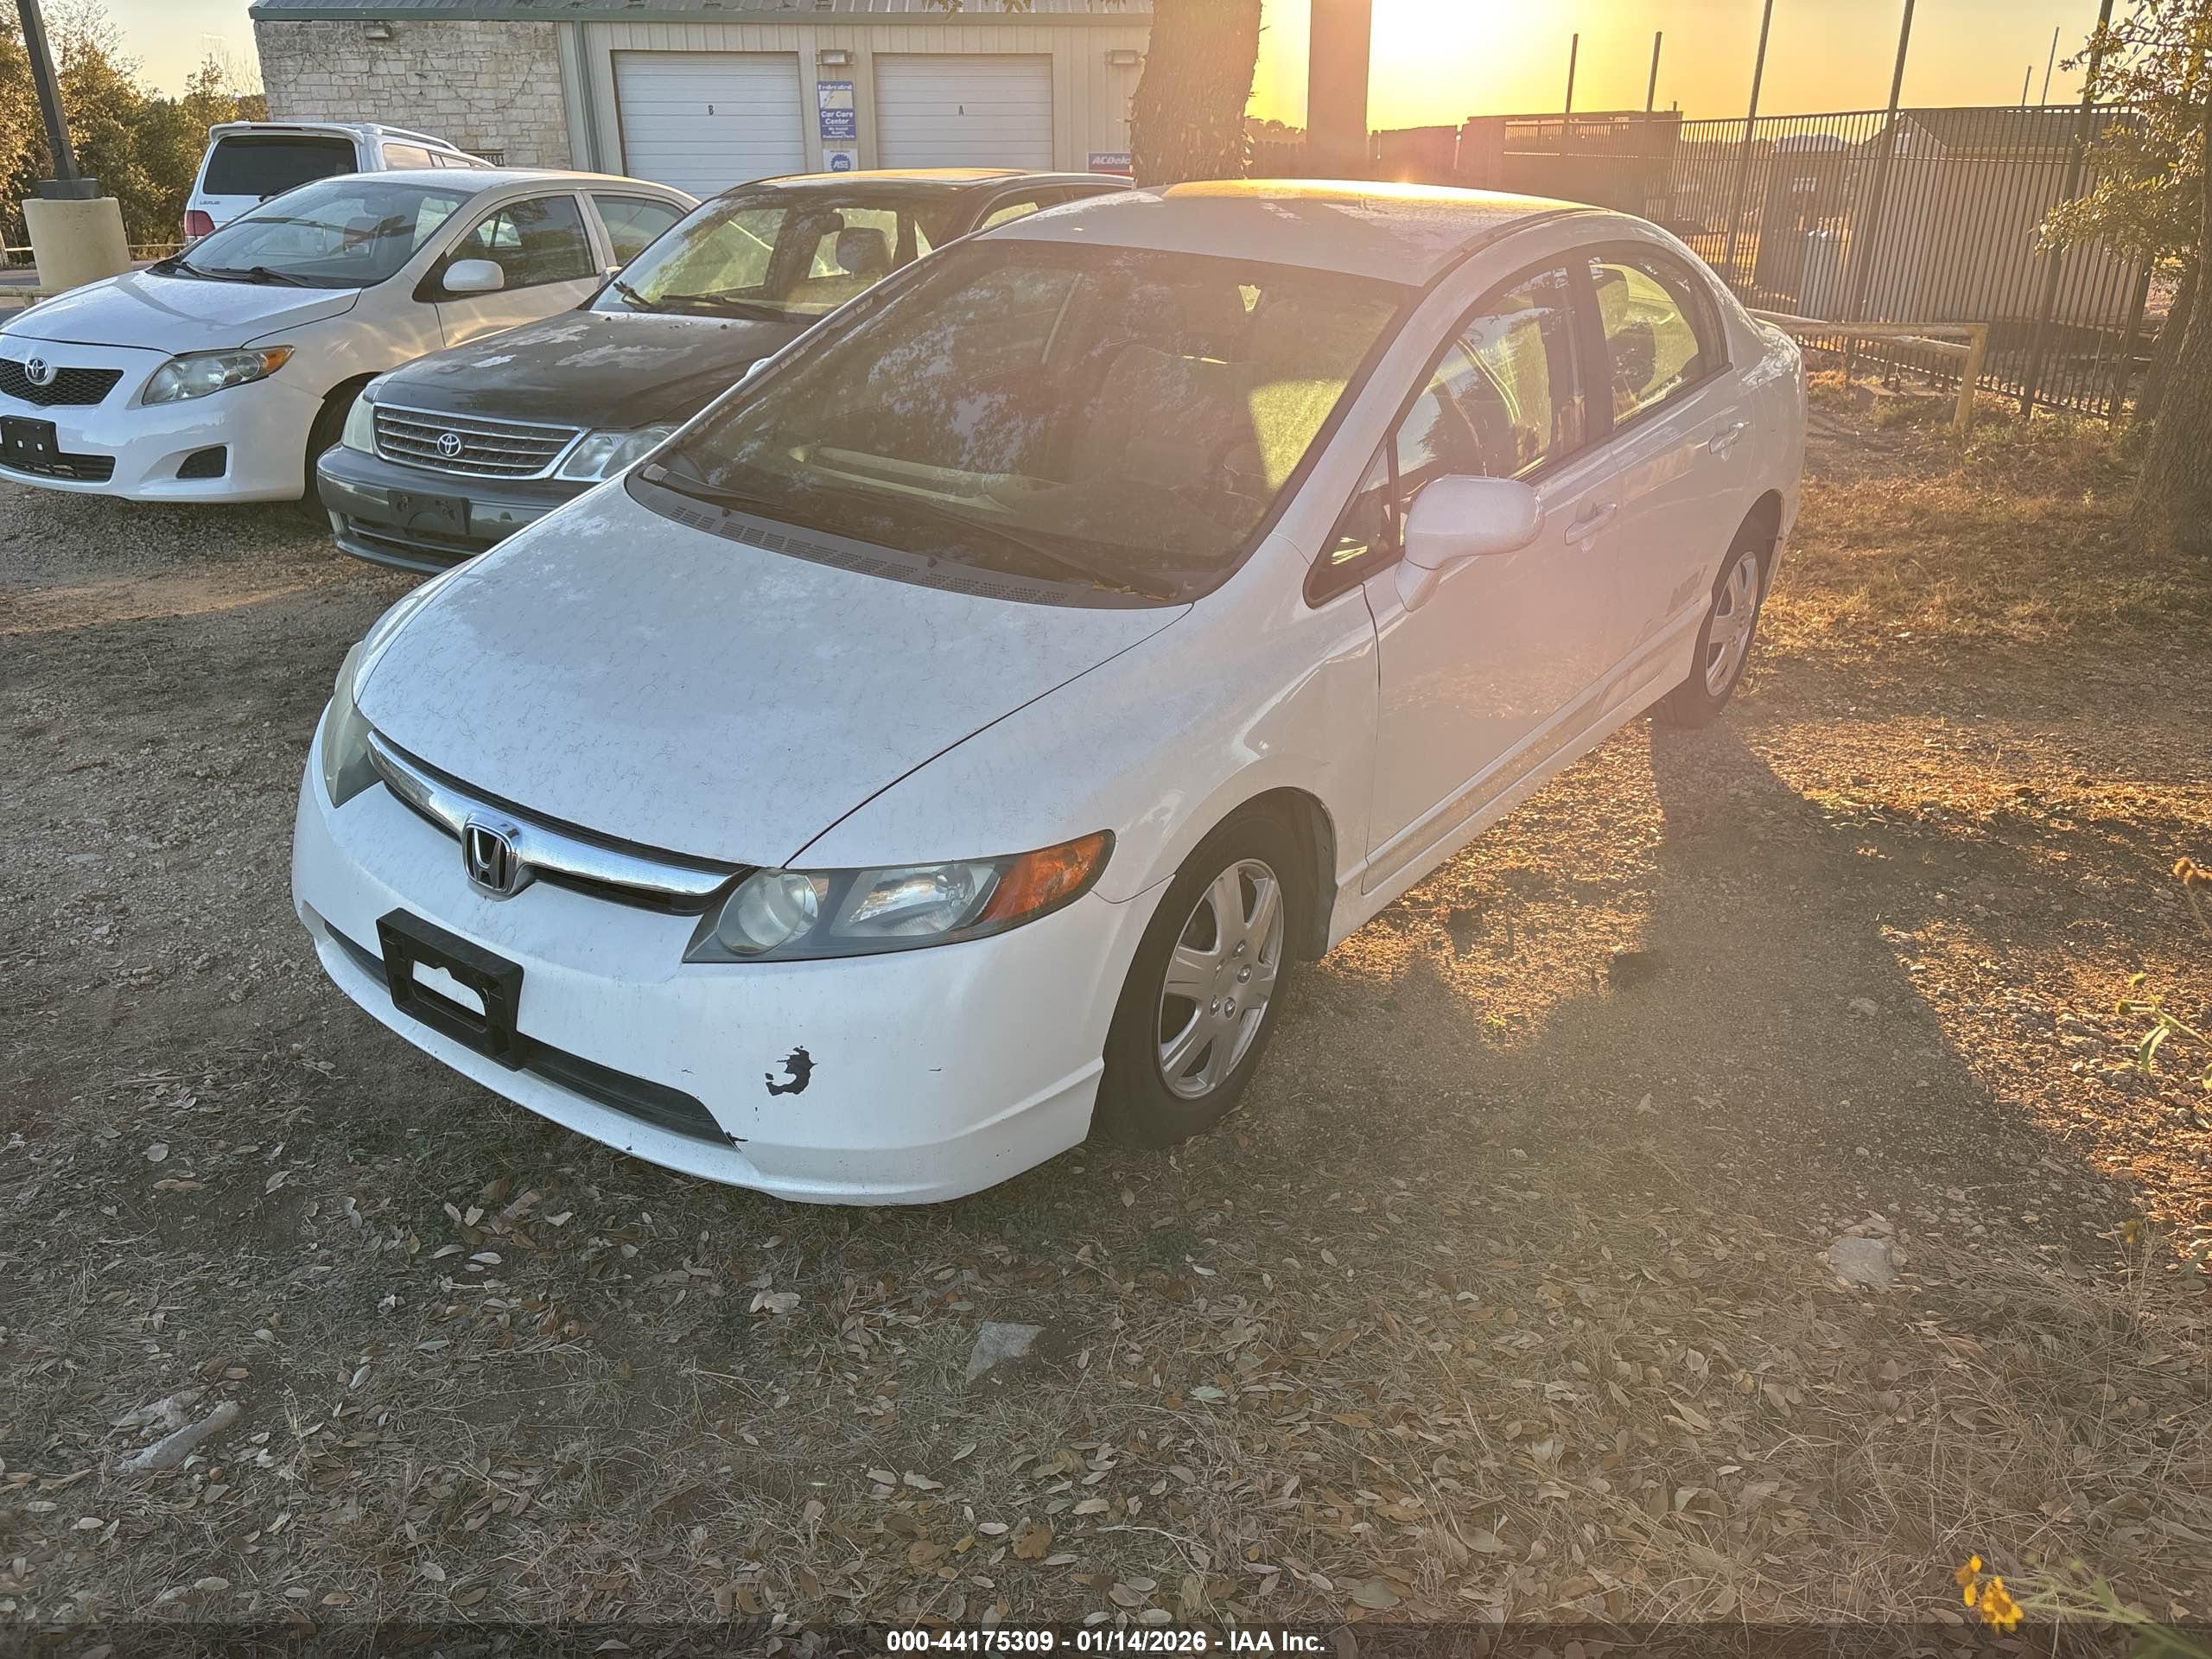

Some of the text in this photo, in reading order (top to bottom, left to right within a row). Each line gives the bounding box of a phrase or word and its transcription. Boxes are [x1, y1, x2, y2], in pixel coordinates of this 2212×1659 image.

[708, 105, 715, 116] B
[958, 105, 964, 116] A
[832, 160, 849, 168] ASE
[1091, 155, 1131, 164] ACDelc
